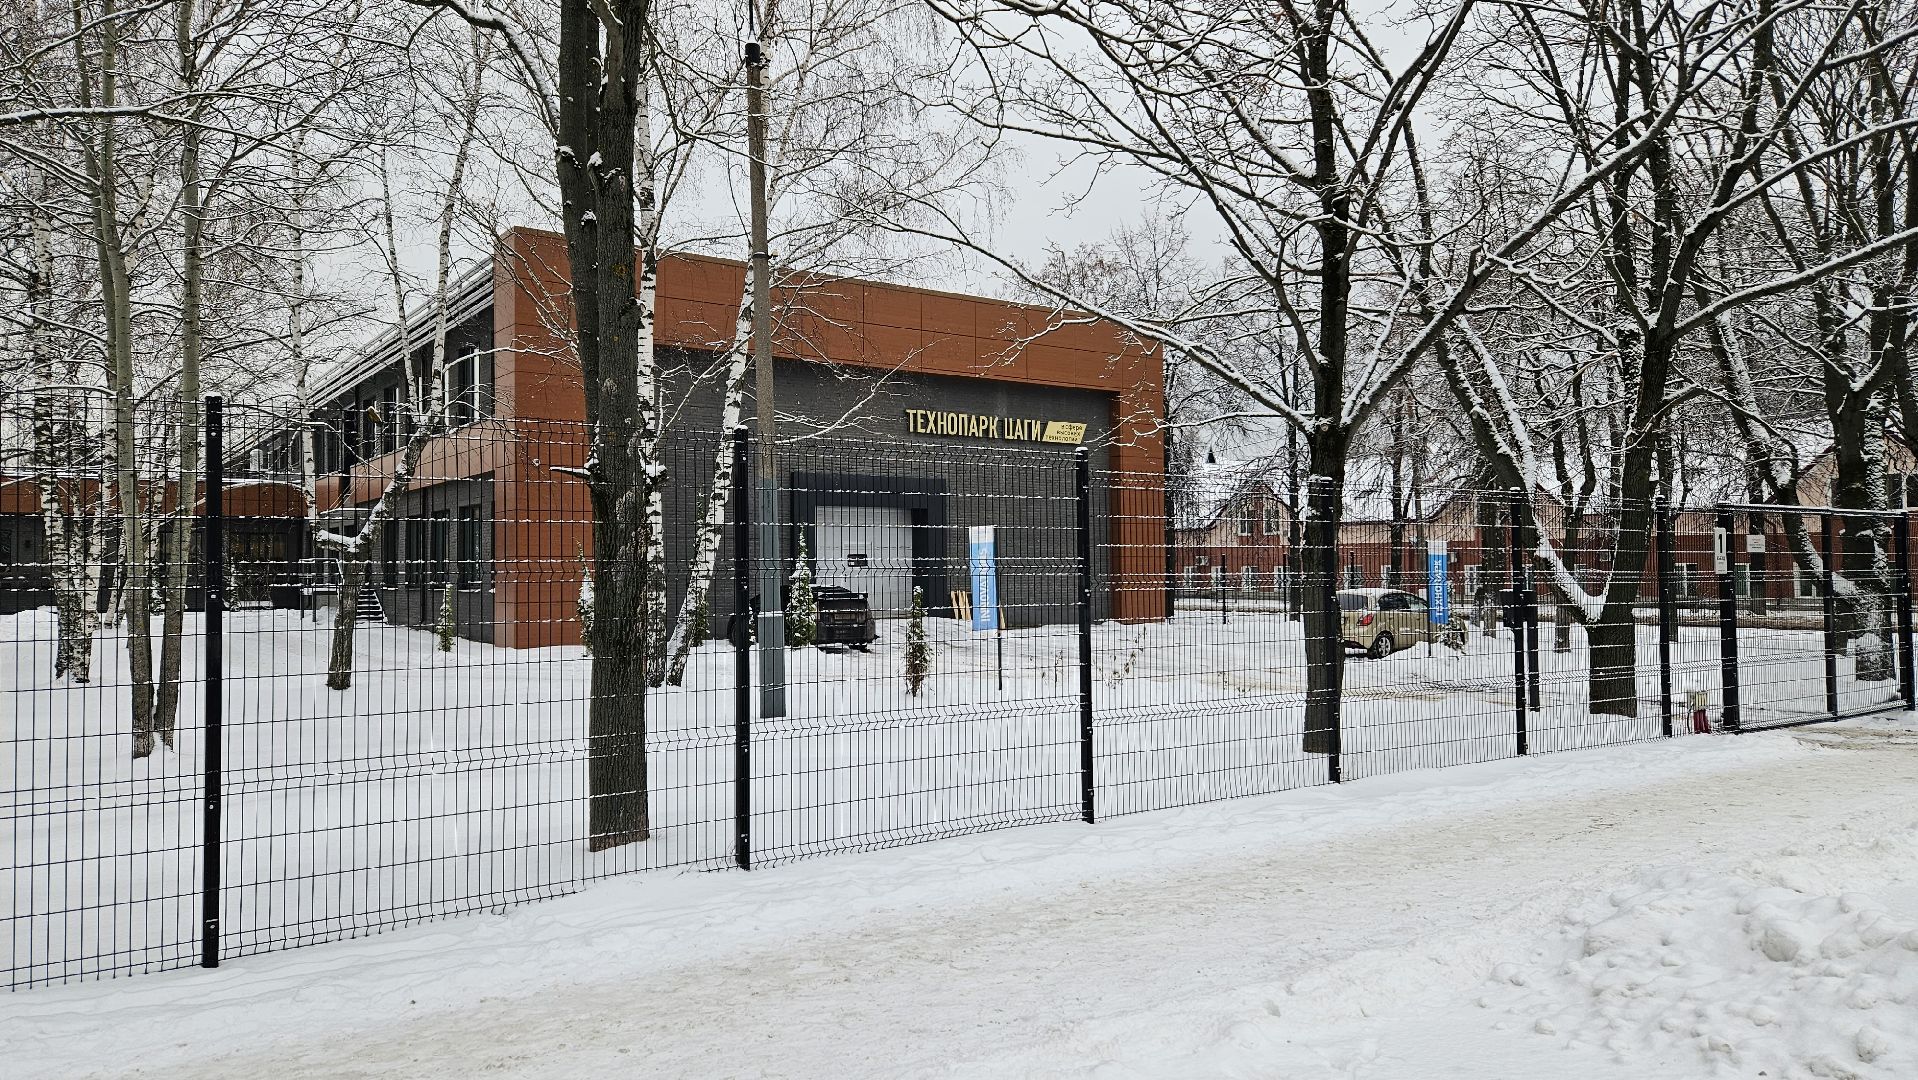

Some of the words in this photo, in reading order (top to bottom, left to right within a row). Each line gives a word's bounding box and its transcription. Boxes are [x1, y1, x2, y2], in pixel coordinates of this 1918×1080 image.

[906, 409, 998, 439] ТЕХНОПАРК
[1004, 417, 1041, 442] ЦАГИ
[1718, 533, 1723, 554] 1
